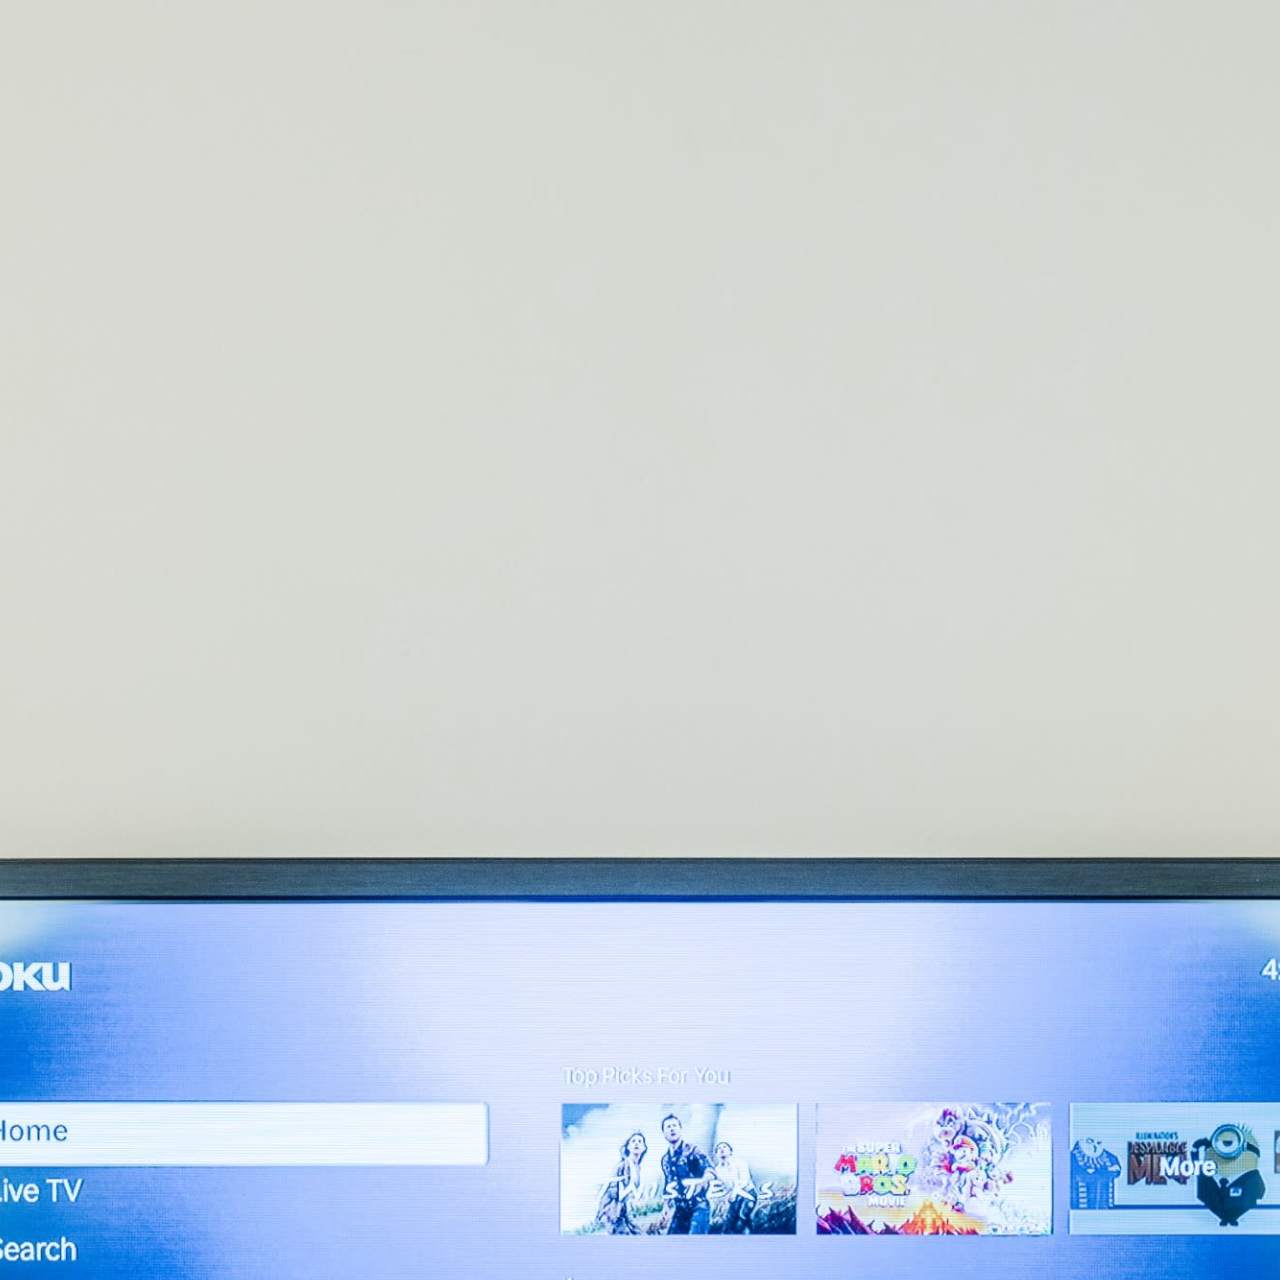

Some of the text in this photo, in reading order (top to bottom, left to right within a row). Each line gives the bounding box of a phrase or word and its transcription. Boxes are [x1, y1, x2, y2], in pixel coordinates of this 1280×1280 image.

[563, 1066, 732, 1088] Top Picks For You
[1160, 1157, 1217, 1176] More
[46, 1179, 84, 1203] TV
[598, 1177, 775, 1202] TWISTERS
